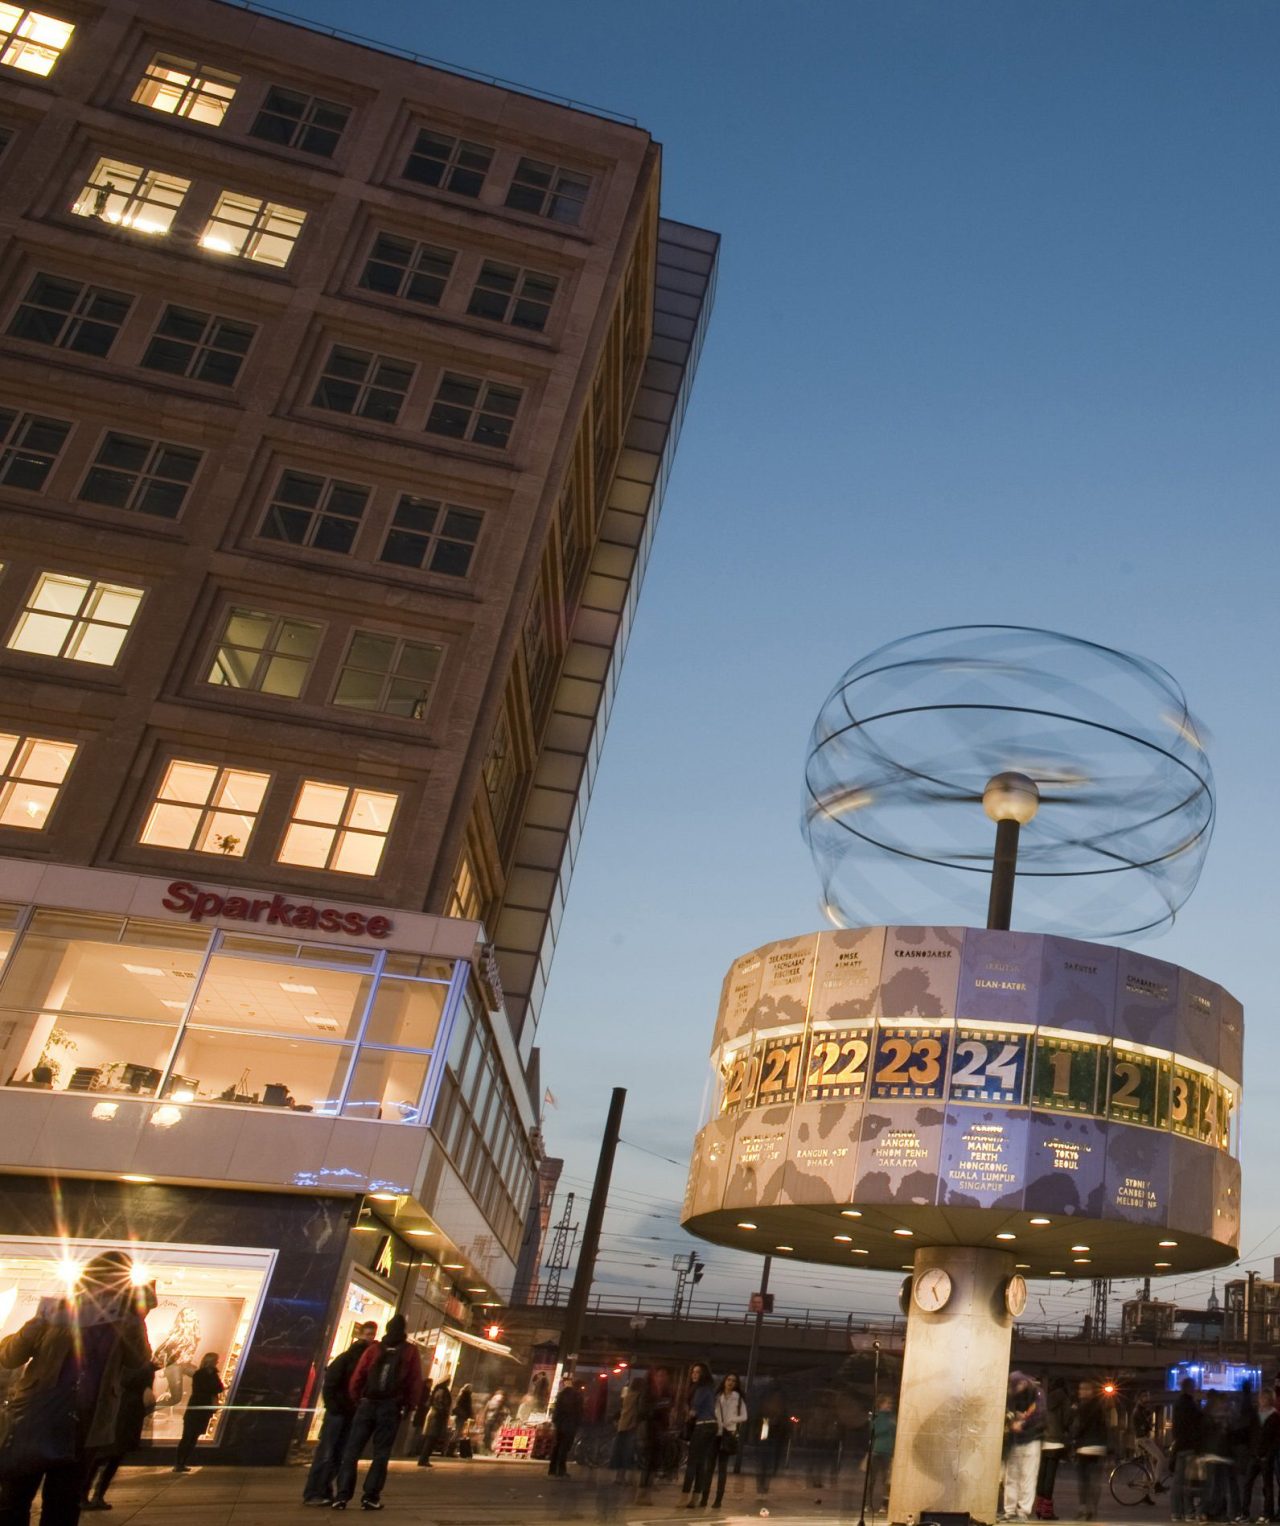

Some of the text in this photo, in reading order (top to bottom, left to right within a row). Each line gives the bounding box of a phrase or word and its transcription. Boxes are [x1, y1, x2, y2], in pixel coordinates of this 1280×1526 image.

[162, 880, 395, 939] Sparkasse
[808, 1040, 869, 1086] 22
[875, 1038, 942, 1084] 23
[951, 1041, 1020, 1089] 24
[760, 1047, 801, 1093] 21
[1050, 1051, 1072, 1097] 1
[1112, 1063, 1141, 1108] 2
[1171, 1077, 1188, 1120] 3
[881, 1139, 920, 1148] BANGKOK
[967, 1142, 1003, 1152] MANILA
[796, 1149, 828, 1158] RANGUN
[905, 1149, 928, 1158] PENH
[970, 1152, 998, 1162] PERTH
[1055, 1149, 1079, 1160] TOKYO
[878, 1158, 918, 1168] JAKARTA
[959, 1161, 1009, 1172] HONGKONG
[1053, 1159, 1079, 1170] SEOUL
[949, 1170, 1016, 1182] KUALA LUMPUR
[959, 1181, 1004, 1192] SINGAPUR
